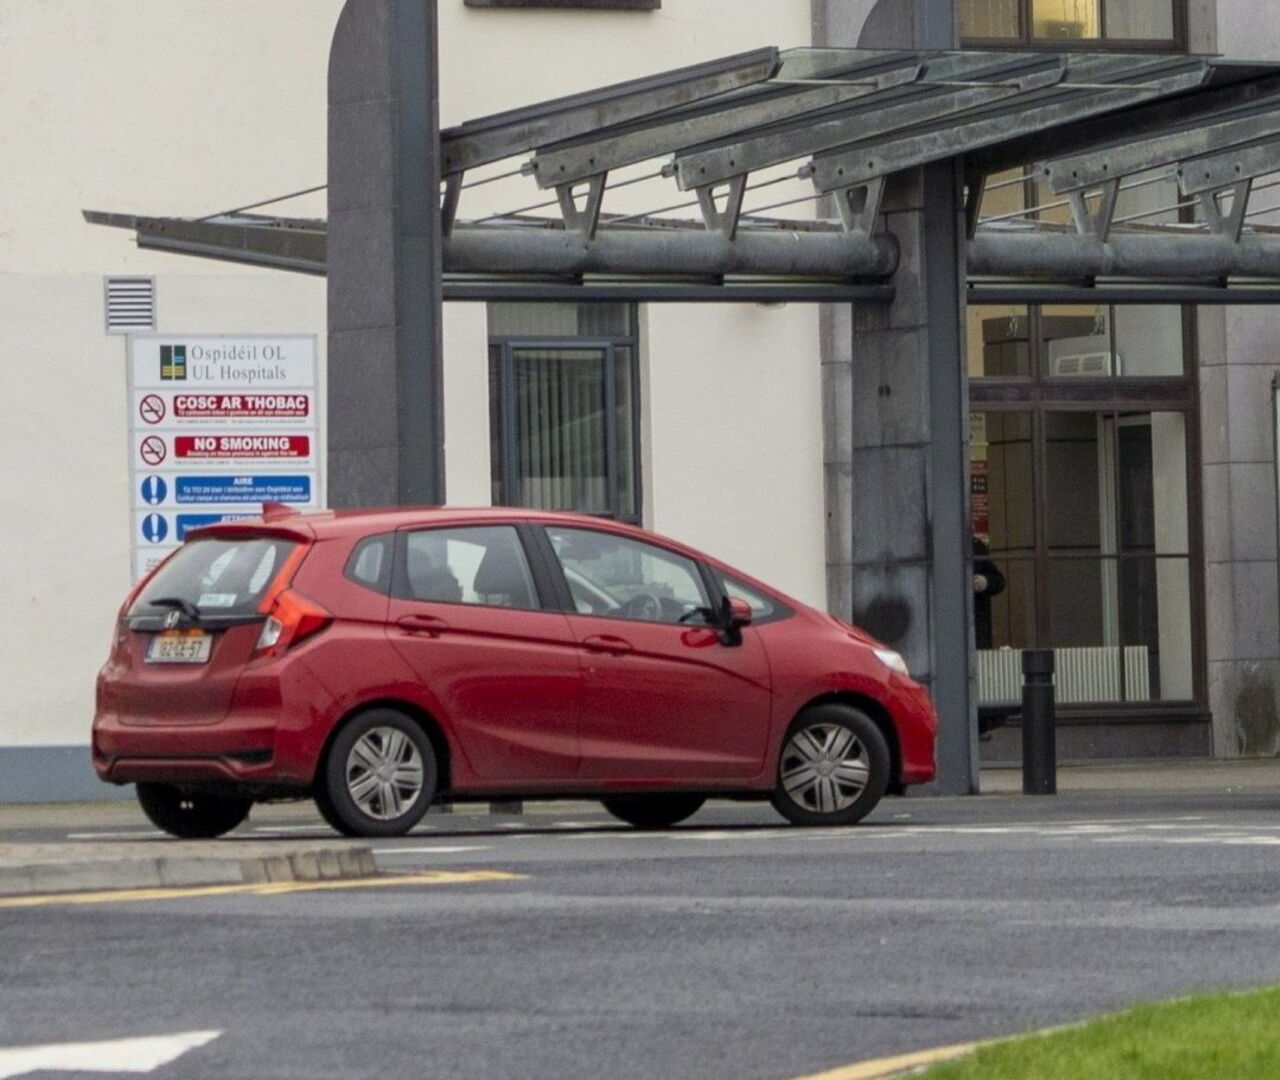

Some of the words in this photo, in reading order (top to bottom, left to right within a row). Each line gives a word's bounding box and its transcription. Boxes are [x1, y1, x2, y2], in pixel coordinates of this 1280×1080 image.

[191, 345, 257, 364] Ospidéil
[262, 346, 287, 361] OL
[192, 366, 214, 381] UL
[219, 366, 287, 383] Hospitals
[176, 396, 217, 409] COSC
[221, 396, 241, 409] AR
[245, 396, 306, 409] THOBAC
[194, 438, 216, 451] NO
[220, 438, 290, 451] SMOKING
